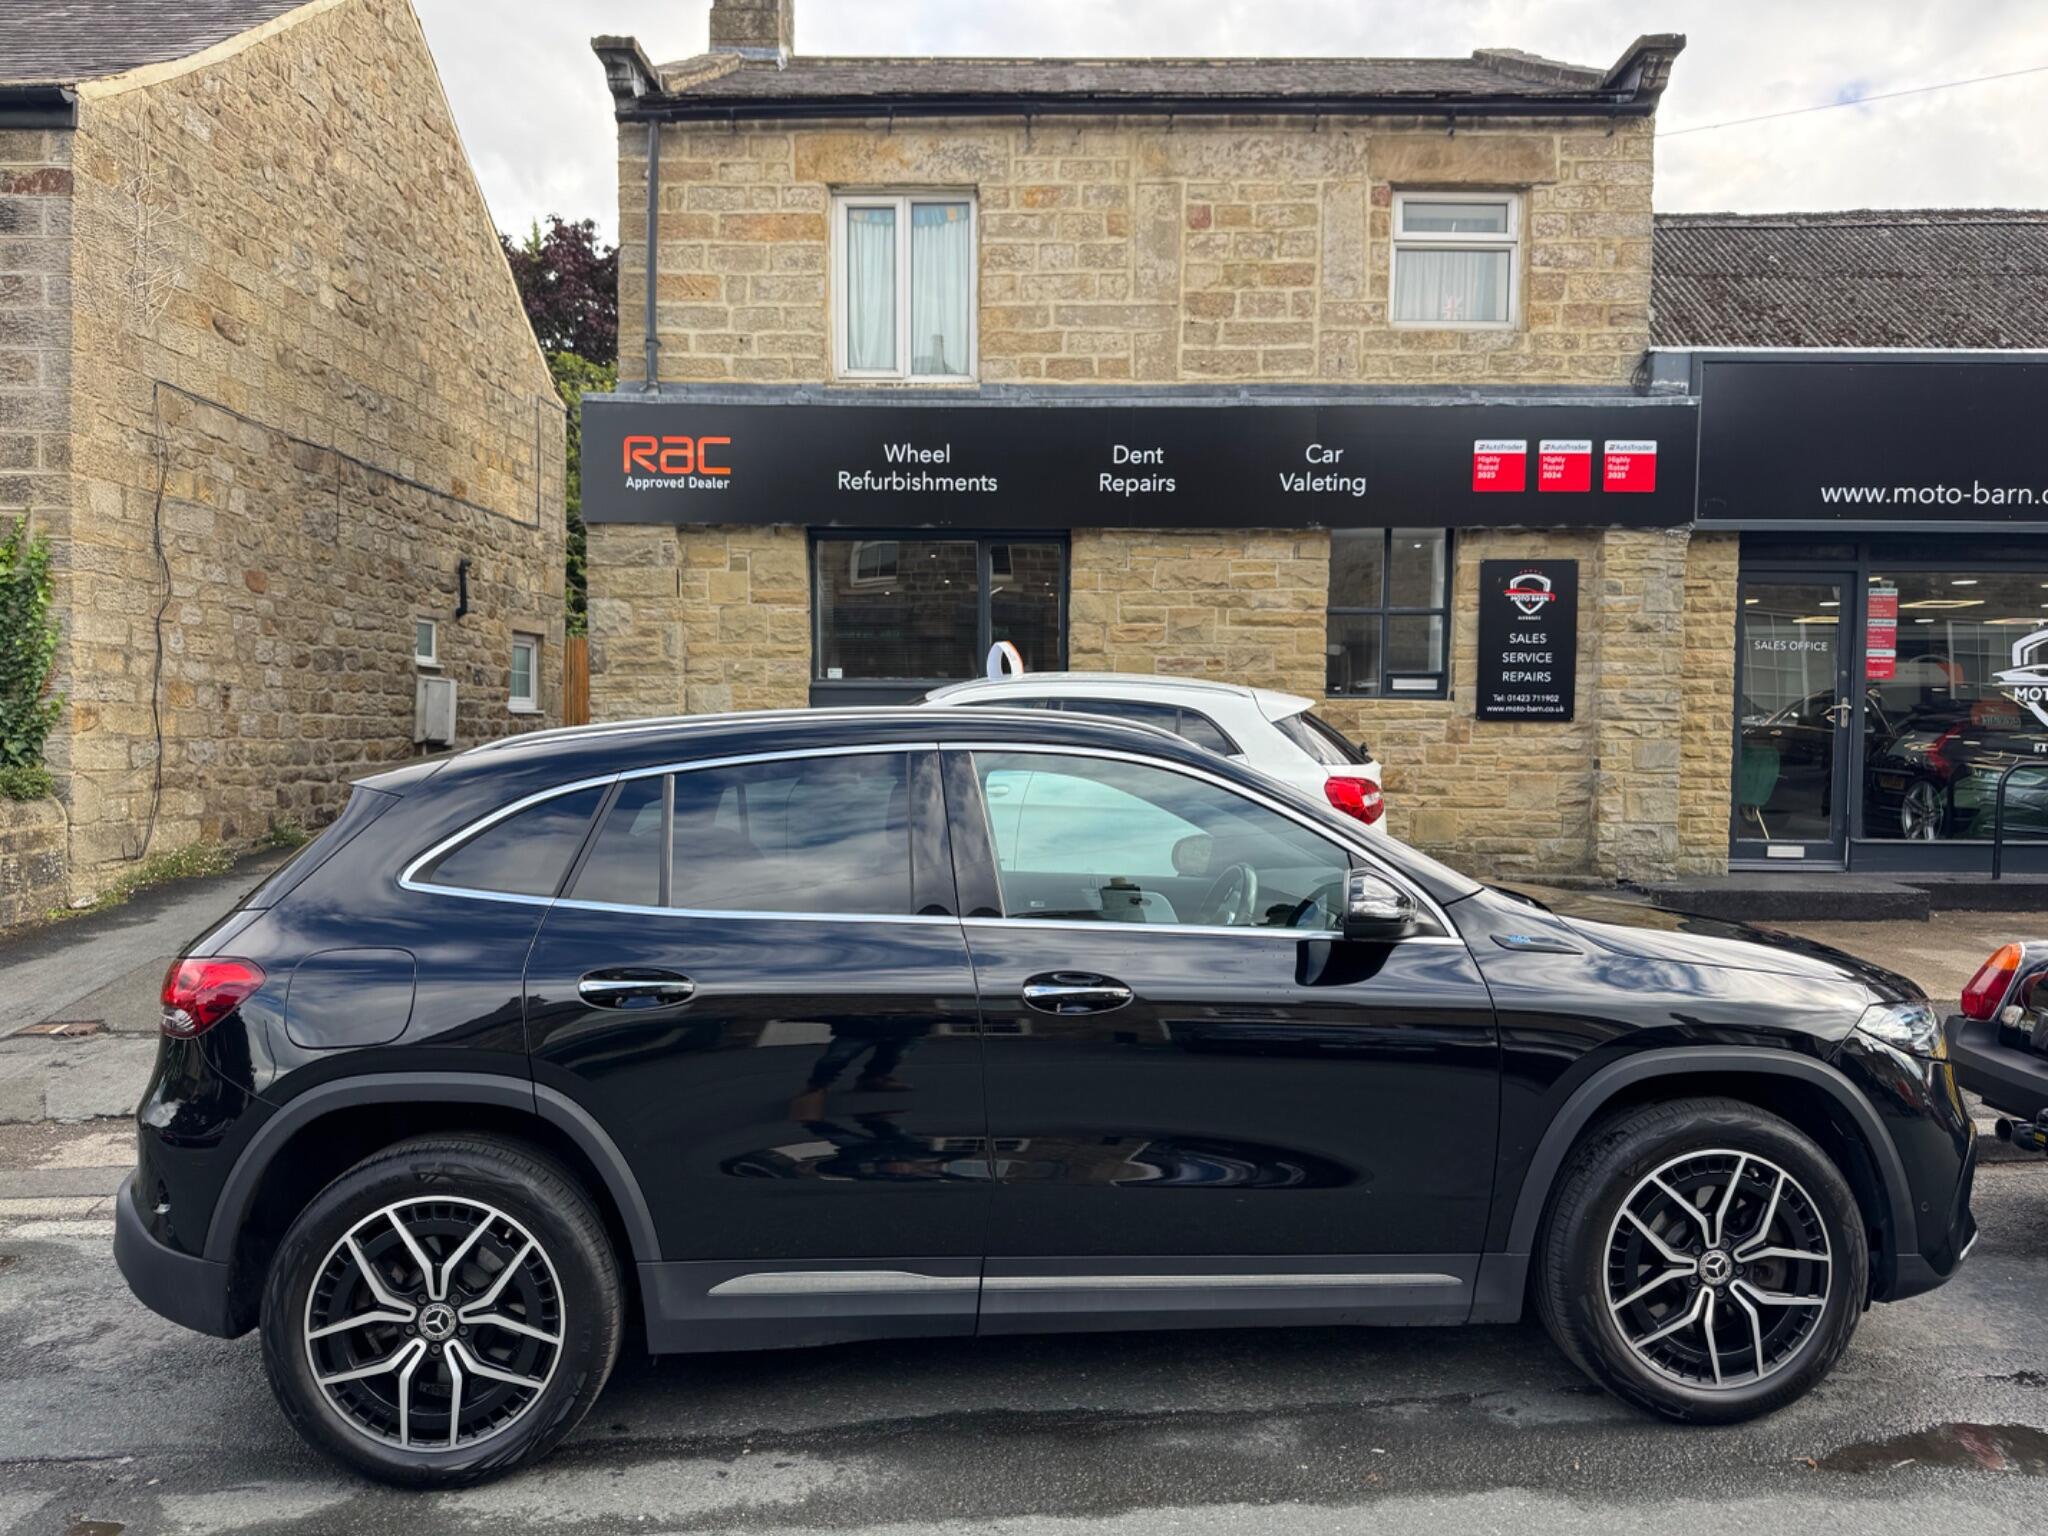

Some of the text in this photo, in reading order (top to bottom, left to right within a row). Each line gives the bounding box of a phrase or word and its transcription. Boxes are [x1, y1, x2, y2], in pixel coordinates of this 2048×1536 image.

[883, 443, 951, 464] Wheel
[1113, 444, 1164, 464] Dent
[1305, 443, 1344, 464] Car
[1478, 456, 1501, 464] Highly
[1543, 456, 1566, 464] Highly
[1608, 456, 1631, 464] Highly
[1478, 463, 1499, 471] Rated
[1543, 463, 1564, 471] Rated
[1608, 463, 1629, 471] Rated
[625, 476, 731, 491] Approved Dealer
[838, 470, 998, 491] Refurbishments
[1099, 472, 1176, 497] Repairs
[1279, 471, 1366, 497] Valeting
[1509, 633, 1547, 644] SALES
[1754, 640, 1829, 652] SALES OFFICE
[1502, 652, 1553, 663] SERVICE
[1502, 671, 1552, 682] REPAIRS
[1507, 694, 1531, 702] 01423
[1532, 694, 1560, 702] 711902
[1486, 705, 1565, 713] www.moto-barn.co.uk
